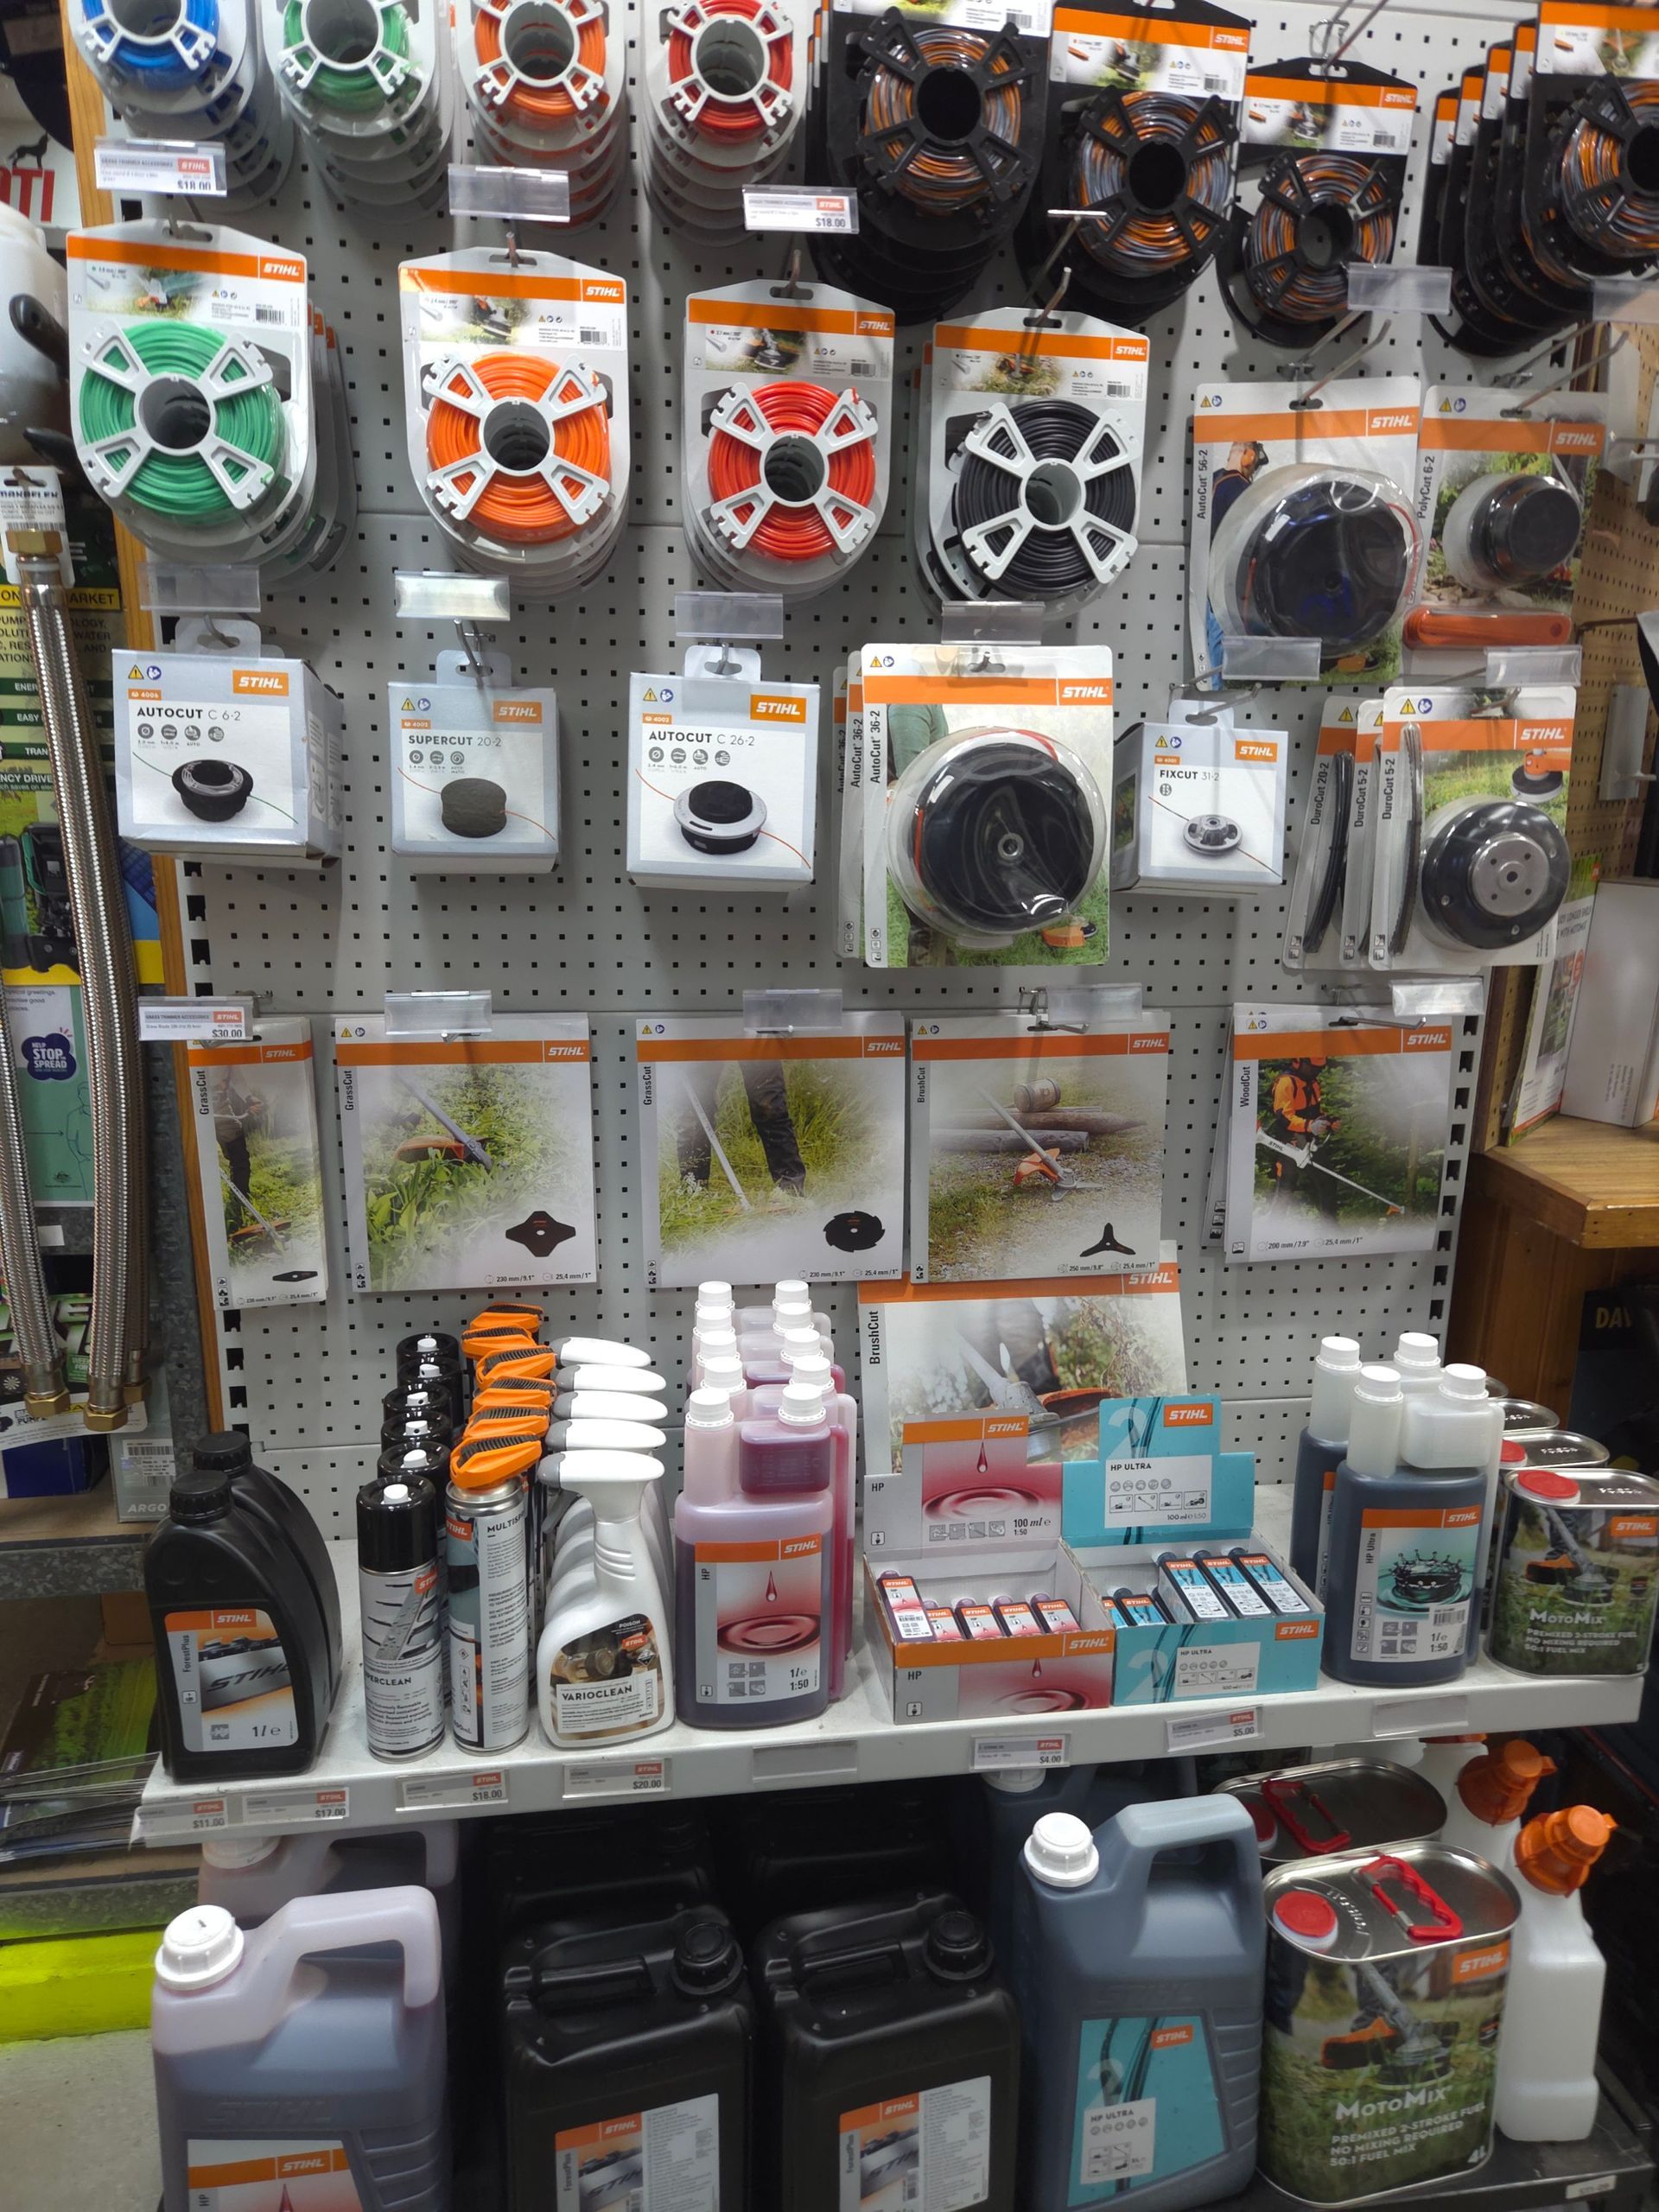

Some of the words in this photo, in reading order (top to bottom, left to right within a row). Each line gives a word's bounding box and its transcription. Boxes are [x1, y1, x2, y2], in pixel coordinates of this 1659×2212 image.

[1214, 33, 1245, 47] STIHL
[1384, 92, 1414, 105] STIHL
[181, 162, 207, 171] STIHL
[816, 218, 846, 227] $18.00
[264, 263, 300, 276] STIHL
[585, 286, 620, 297] STIHL
[859, 321, 891, 332] STIHL
[1115, 345, 1147, 356] STIHL
[1370, 414, 1413, 429] STIHL
[1556, 431, 1597, 447] STIHL
[1197, 448, 1209, 471] 56-2
[1424, 454, 1436, 474] 6-2
[1197, 473, 1208, 520] AutoCut
[1417, 478, 1433, 519] PolyCut
[69, 594, 115, 605] ARKET
[238, 677, 283, 690] STIHL
[1062, 686, 1108, 698] STIHL
[137, 706, 204, 719] AUTOCUT
[207, 709, 218, 721] C
[498, 706, 537, 717] STIHL
[756, 702, 801, 715] STIHL
[16, 713, 40, 721] EASY
[870, 709, 881, 734] 36-2
[853, 717, 864, 741] 36-2
[1521, 728, 1564, 741] STIHL
[408, 734, 474, 747] SUPERCUT
[648, 730, 713, 744] AUTOCUT
[716, 734, 727, 745] C
[1239, 746, 1274, 757] STIHL
[850, 742, 862, 788] AutoCut
[869, 734, 881, 785] AutoCut
[1385, 757, 1395, 772] 5-2
[1160, 769, 1198, 780] FIXCUT
[1359, 768, 1369, 782] 5-2
[1310, 779, 1325, 826] DuroCut
[1318, 761, 1330, 779] 20-2
[1382, 773, 1394, 820] DuroCut
[1354, 783, 1365, 828] DuroCut
[212, 1029, 243, 1039] $30.00
[1407, 1033, 1446, 1046] STIHL
[867, 1042, 901, 1052] STIHL
[1132, 1039, 1165, 1048] STIHL
[33, 1048, 63, 1060] STOP
[265, 1049, 296, 1058] STIHL
[548, 1046, 584, 1056] STIHL
[34, 1060, 67, 1069] SPREAD
[345, 1070, 354, 1111] GrassCut
[643, 1065, 652, 1106] GrassCut
[917, 1066, 925, 1103] BrushCut
[1239, 1065, 1251, 1108] WoodCut
[199, 1070, 210, 1116] GrassCut
[1268, 1241, 1280, 1249] 200
[1128, 1273, 1173, 1285] STIHL
[868, 1310, 881, 1365] BrushCut
[1168, 1408, 1208, 1421] STIHL
[988, 1422, 1023, 1433] STIHL
[871, 1483, 885, 1492] HP
[127, 1503, 167, 1513] ARGO
[1014, 1518, 1028, 1528] 100
[1029, 1517, 1043, 1527] ml
[1447, 1513, 1478, 1522] STIHL
[1615, 1522, 1653, 1531] STIHL
[784, 1540, 817, 1554] STIHL
[1367, 1532, 1376, 1552] Ultra
[1365, 1553, 1374, 1565] HP
[701, 1567, 711, 1580] HP
[965, 1607, 989, 1616] STIHL
[1003, 1605, 1027, 1613] STIHL
[1042, 1602, 1065, 1611] STIHL
[217, 1613, 252, 1624] STIHL
[1280, 1625, 1315, 1636] STIHL
[1069, 1637, 1107, 1649] STIHL
[1430, 1643, 1449, 1653] 1:50
[181, 1634, 191, 1674] ForestPlus
[907, 1670, 922, 1681] HP
[790, 1678, 809, 1691] 1:50
[562, 1684, 633, 1701] VARIOCLEAN
[1232, 1713, 1252, 1722] STIHL
[1233, 1726, 1255, 1738] $5.00
[1039, 1741, 1060, 1750] STIHL
[1039, 1755, 1061, 1764] $4.00
[476, 1776, 499, 1784] STIHL
[632, 1779, 662, 1790] $20.00
[473, 1789, 503, 1802] $18.00
[315, 1808, 346, 1818] $17.00
[193, 1818, 226, 1829] $11.00
[1459, 1951, 1504, 1974] STIHL
[1156, 2031, 1189, 2044] STIHL
[884, 2100, 915, 2115] STIHL
[1090, 2114, 1103, 2123] HP
[1105, 2109, 1135, 2120] ULTRA
[605, 2120, 637, 2135] STIHL
[1332, 2126, 1397, 2144] PREMIXED
[1399, 2111, 1458, 2133] 2-STROKE
[1330, 2146, 1352, 2156] NO
[1354, 2136, 1402, 2152] MIXING
[1403, 2120, 1465, 2143] REQUIRED
[1330, 2157, 1357, 2167] 50:1
[1359, 2150, 1390, 2164] FUEL
[1393, 2143, 1417, 2156] MIX
[282, 2158, 325, 2172] STIHL
[198, 2194, 210, 2207] HP
